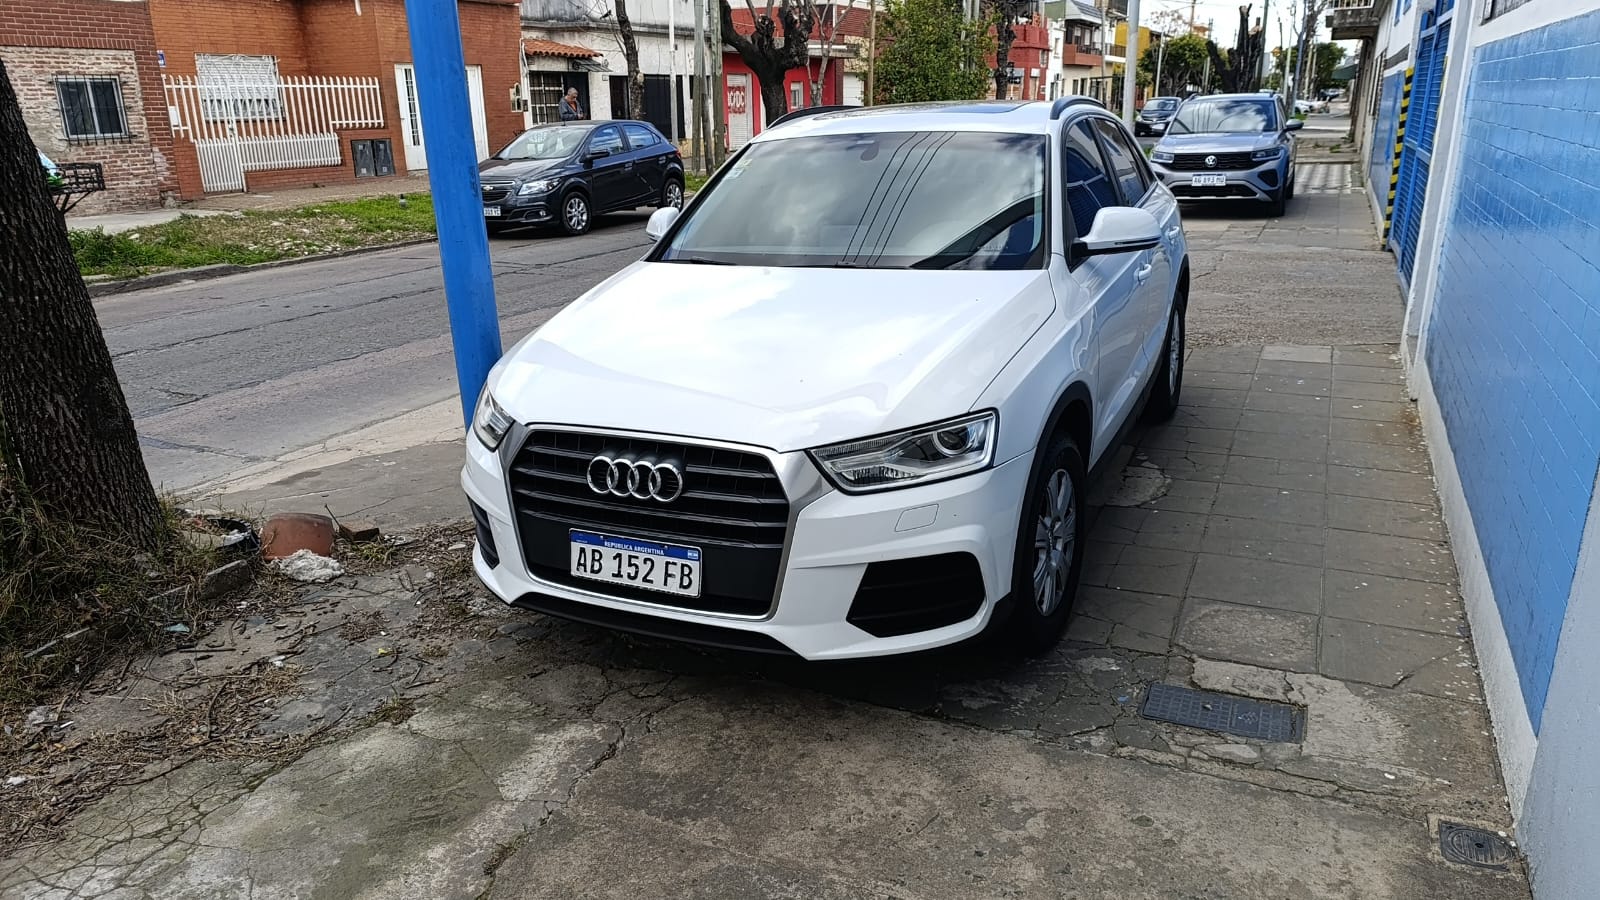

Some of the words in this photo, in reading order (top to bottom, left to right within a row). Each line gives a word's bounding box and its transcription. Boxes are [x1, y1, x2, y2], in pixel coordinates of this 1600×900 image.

[634, 545, 665, 556] ARGENTINA
[576, 546, 603, 575] AB
[611, 552, 655, 585] 152
[663, 560, 693, 590] FB
